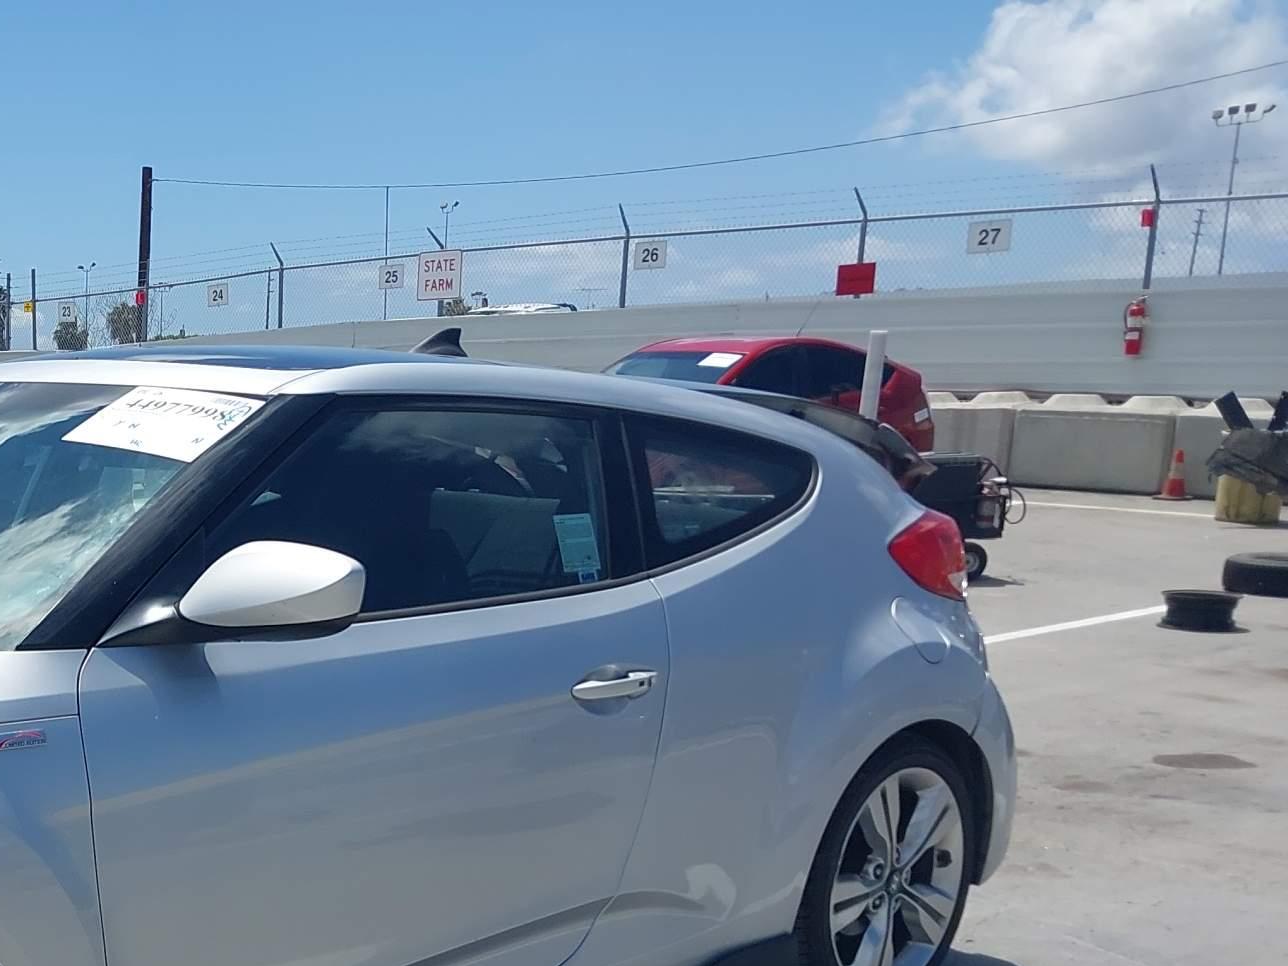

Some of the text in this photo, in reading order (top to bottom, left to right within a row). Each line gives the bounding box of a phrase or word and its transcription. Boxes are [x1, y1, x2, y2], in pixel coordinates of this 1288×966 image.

[977, 227, 1002, 246] 27
[641, 247, 659, 263] 26
[423, 258, 456, 273] STATE
[384, 270, 399, 284] 25
[424, 277, 454, 292] FARM
[212, 288, 224, 302] 24
[61, 306, 72, 318] 23
